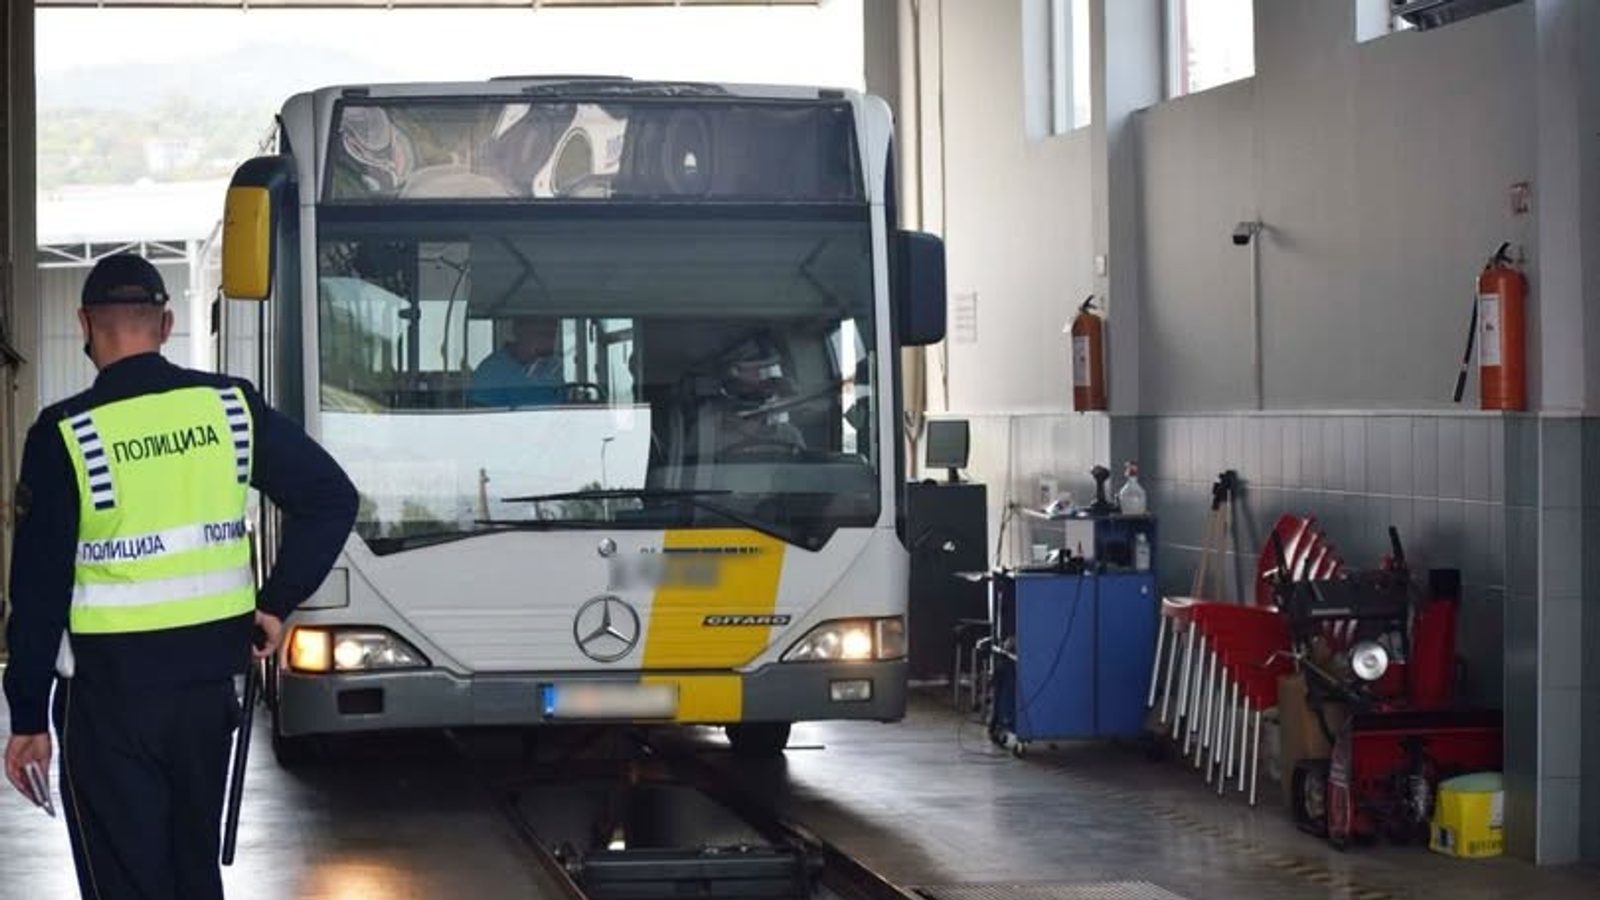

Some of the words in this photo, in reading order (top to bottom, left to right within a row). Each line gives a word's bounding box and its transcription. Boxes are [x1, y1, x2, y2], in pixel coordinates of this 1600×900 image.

[112, 424, 220, 463] ПОЛИЦИЈА
[82, 535, 165, 561] ПОЛИЦИЈА
[706, 615, 788, 626] CITARO
